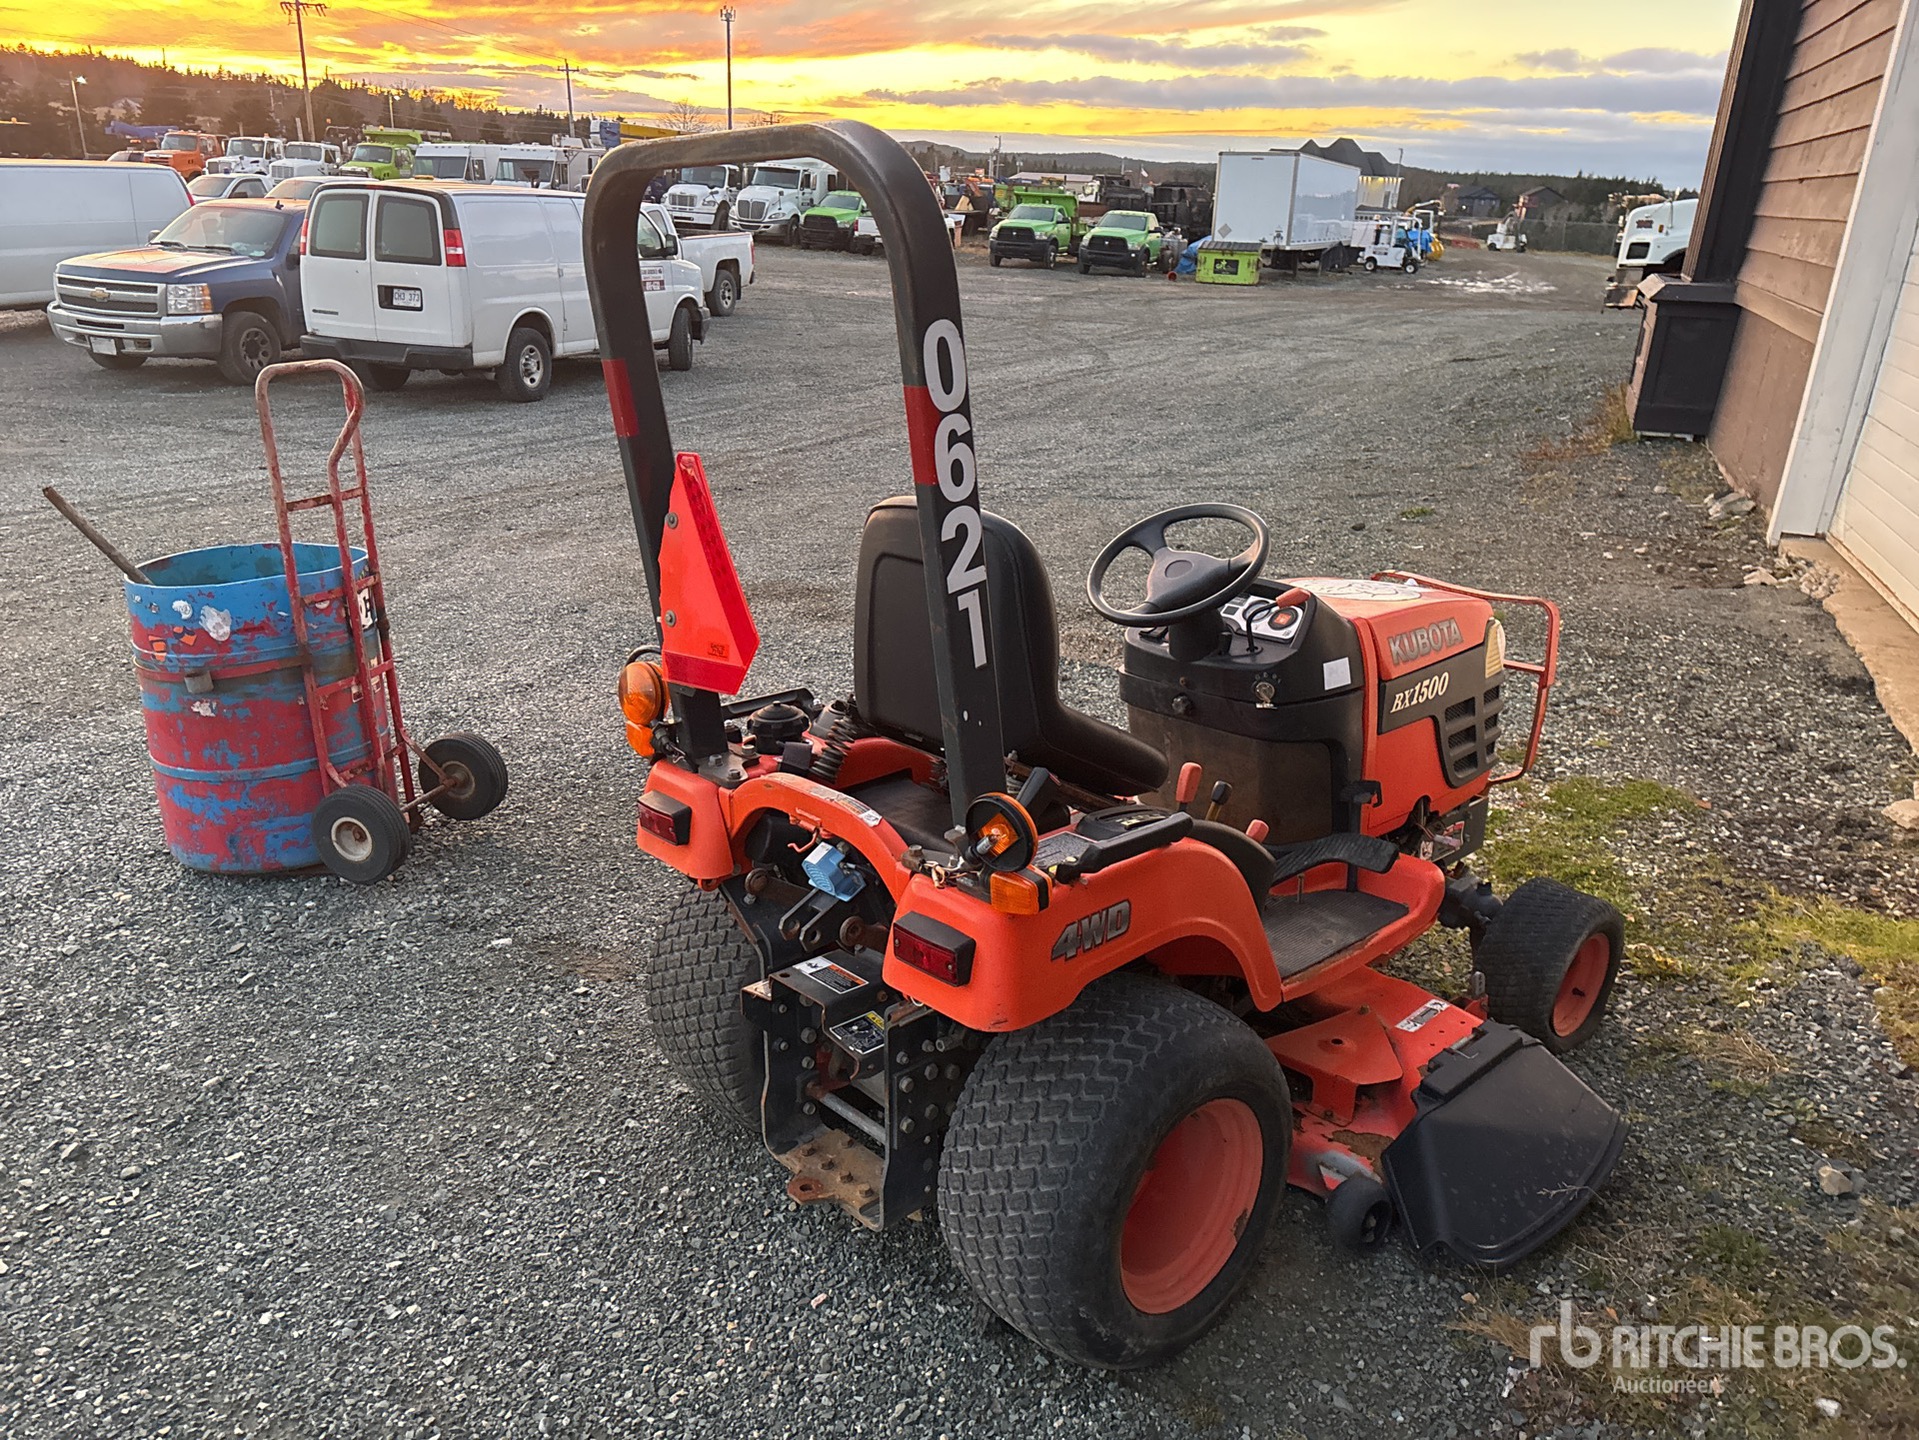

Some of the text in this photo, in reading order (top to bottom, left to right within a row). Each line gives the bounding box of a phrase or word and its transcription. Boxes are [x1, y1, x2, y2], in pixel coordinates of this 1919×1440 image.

[923, 319, 987, 669] 0621
[1387, 616, 1464, 666] KUBOTA
[1389, 671, 1449, 713] BX1500
[1051, 899, 1132, 961] 4WD
